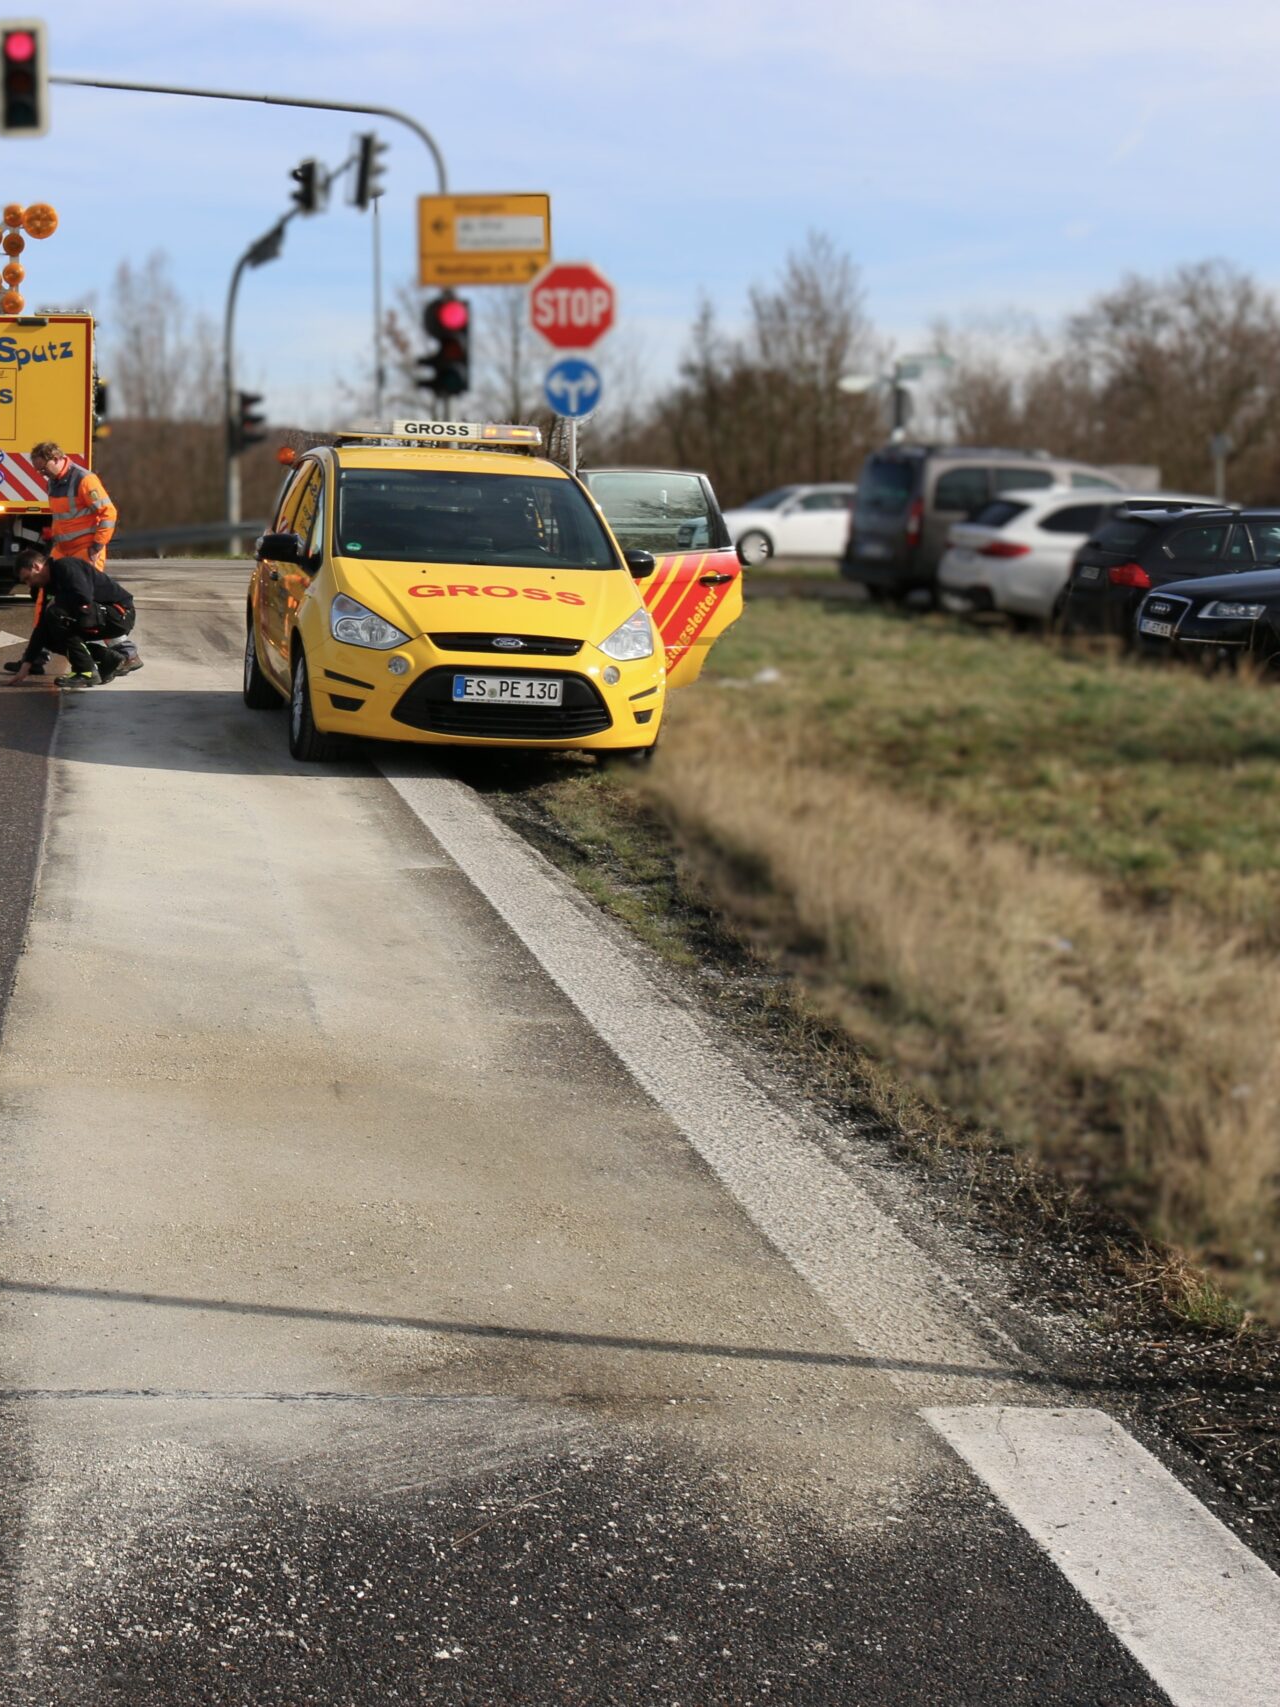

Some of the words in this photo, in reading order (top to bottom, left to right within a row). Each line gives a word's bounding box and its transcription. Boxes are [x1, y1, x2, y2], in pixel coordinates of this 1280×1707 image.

[535, 288, 610, 327] STOP
[404, 422, 470, 437] GROSS
[407, 584, 586, 606] GROSS
[464, 679, 487, 697] ES
[499, 681, 521, 698] PE
[525, 682, 558, 700] 130
